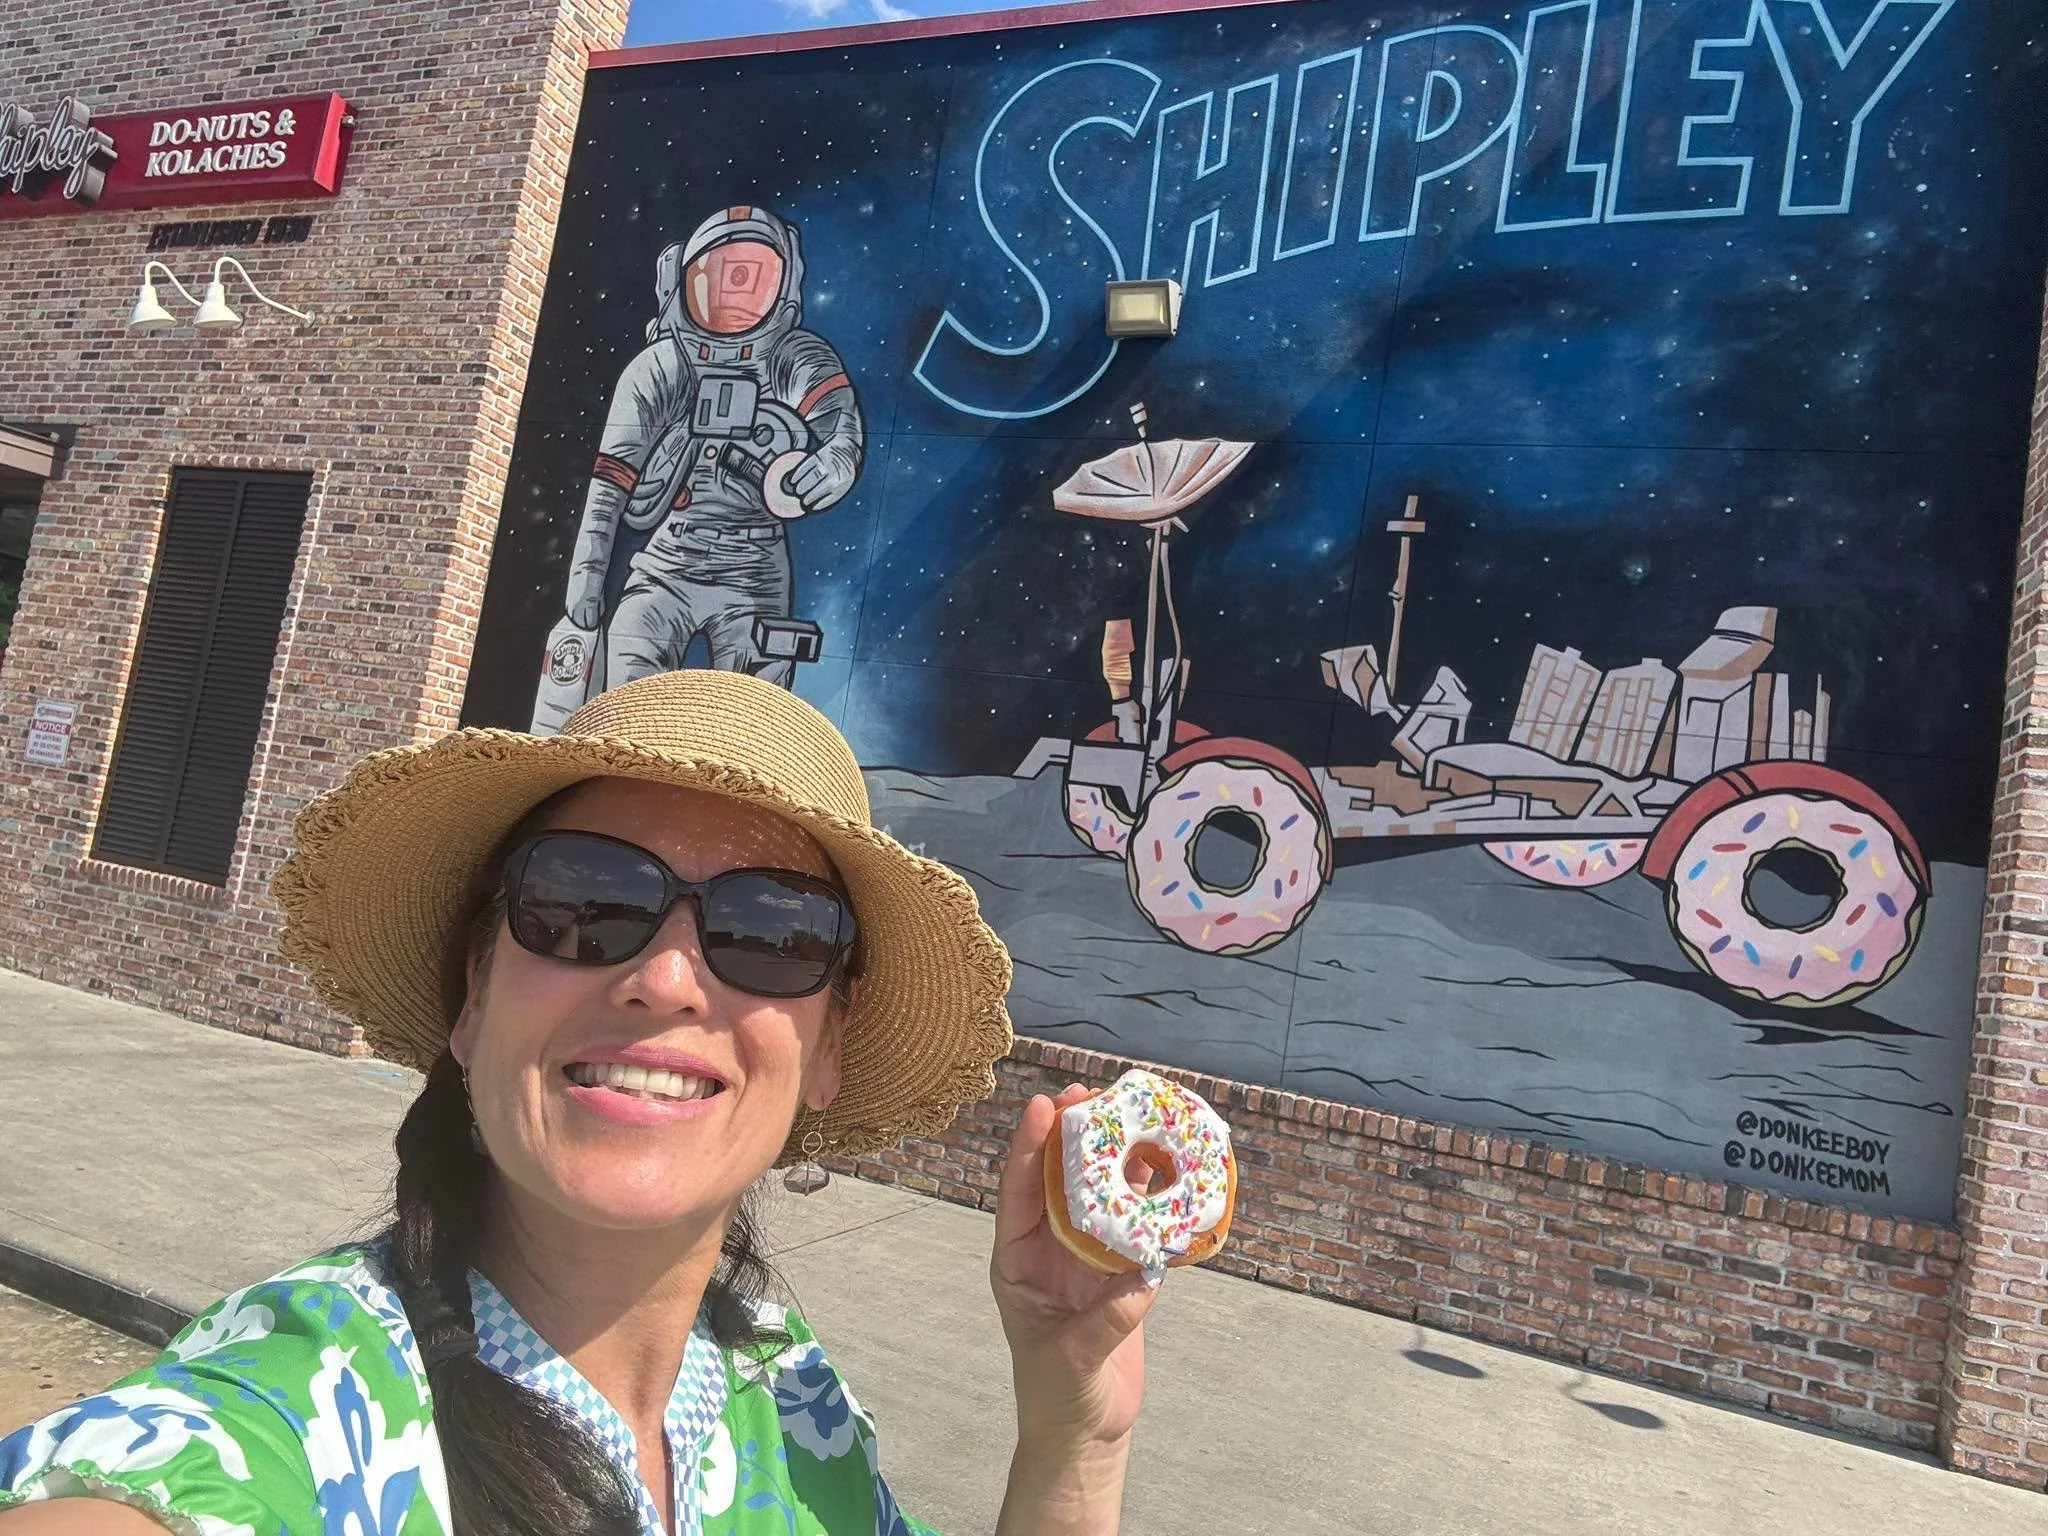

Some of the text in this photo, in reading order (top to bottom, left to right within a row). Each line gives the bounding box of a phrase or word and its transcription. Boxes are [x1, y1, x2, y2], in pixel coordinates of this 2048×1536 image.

[0, 95, 104, 199] hipley
[149, 108, 297, 148] DO-NUTS &
[145, 141, 288, 178] KOLACHES
[912, 0, 1956, 418] SHIPLEY
[35, 720, 67, 733] NOTICE
[1736, 1110, 1891, 1165] @DONKEEBOY
[1723, 1140, 1891, 1196] @DONKEEMOM
